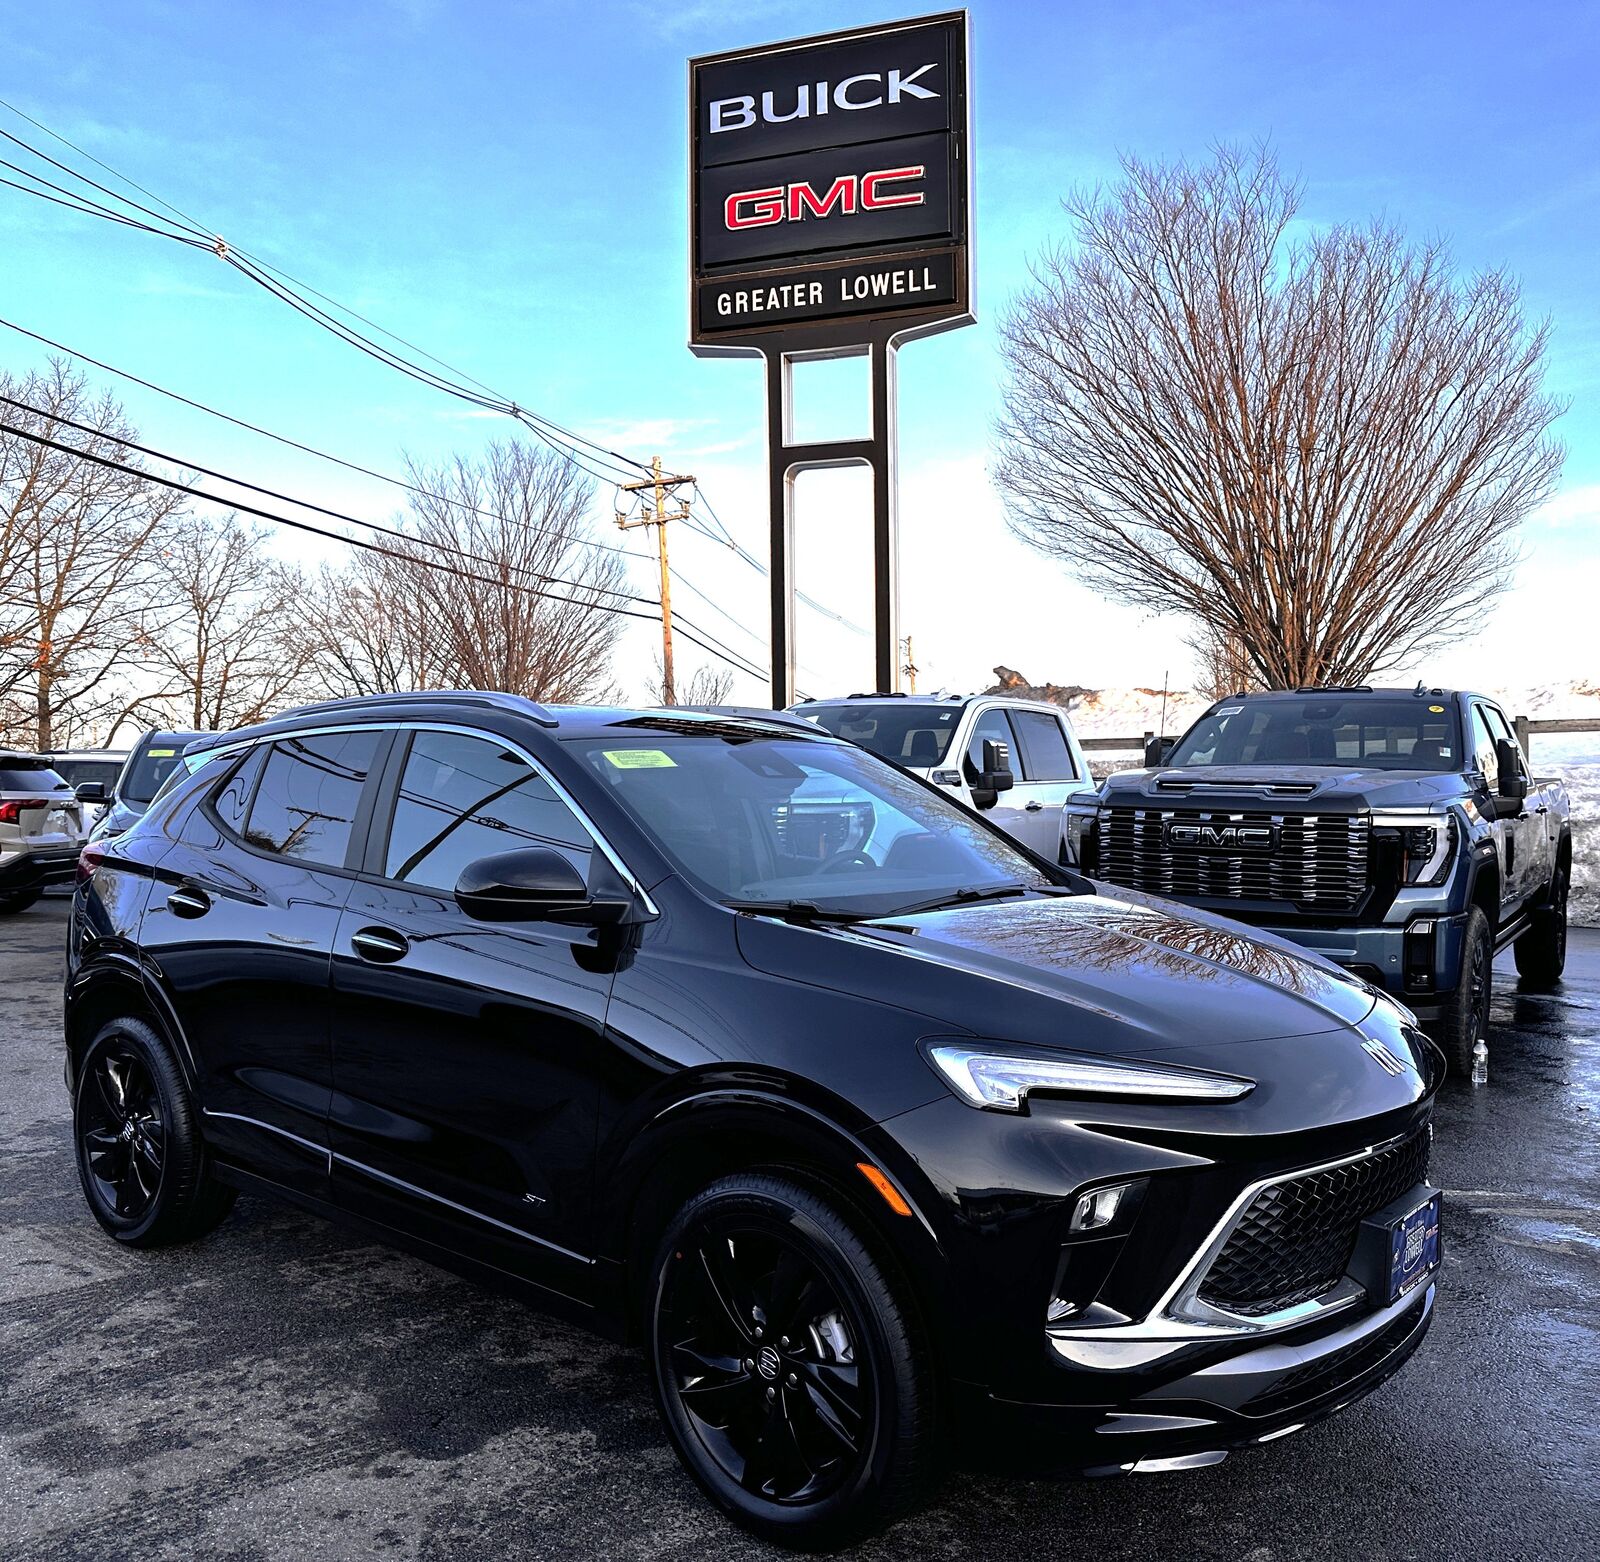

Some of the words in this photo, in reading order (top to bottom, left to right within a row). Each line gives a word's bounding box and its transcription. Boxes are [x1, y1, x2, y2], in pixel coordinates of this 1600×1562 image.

[709, 63, 941, 134] BUICK
[725, 165, 926, 231] GMC
[717, 281, 823, 315] GREATER
[841, 267, 937, 300] LOWELL
[1170, 825, 1270, 847] GMC
